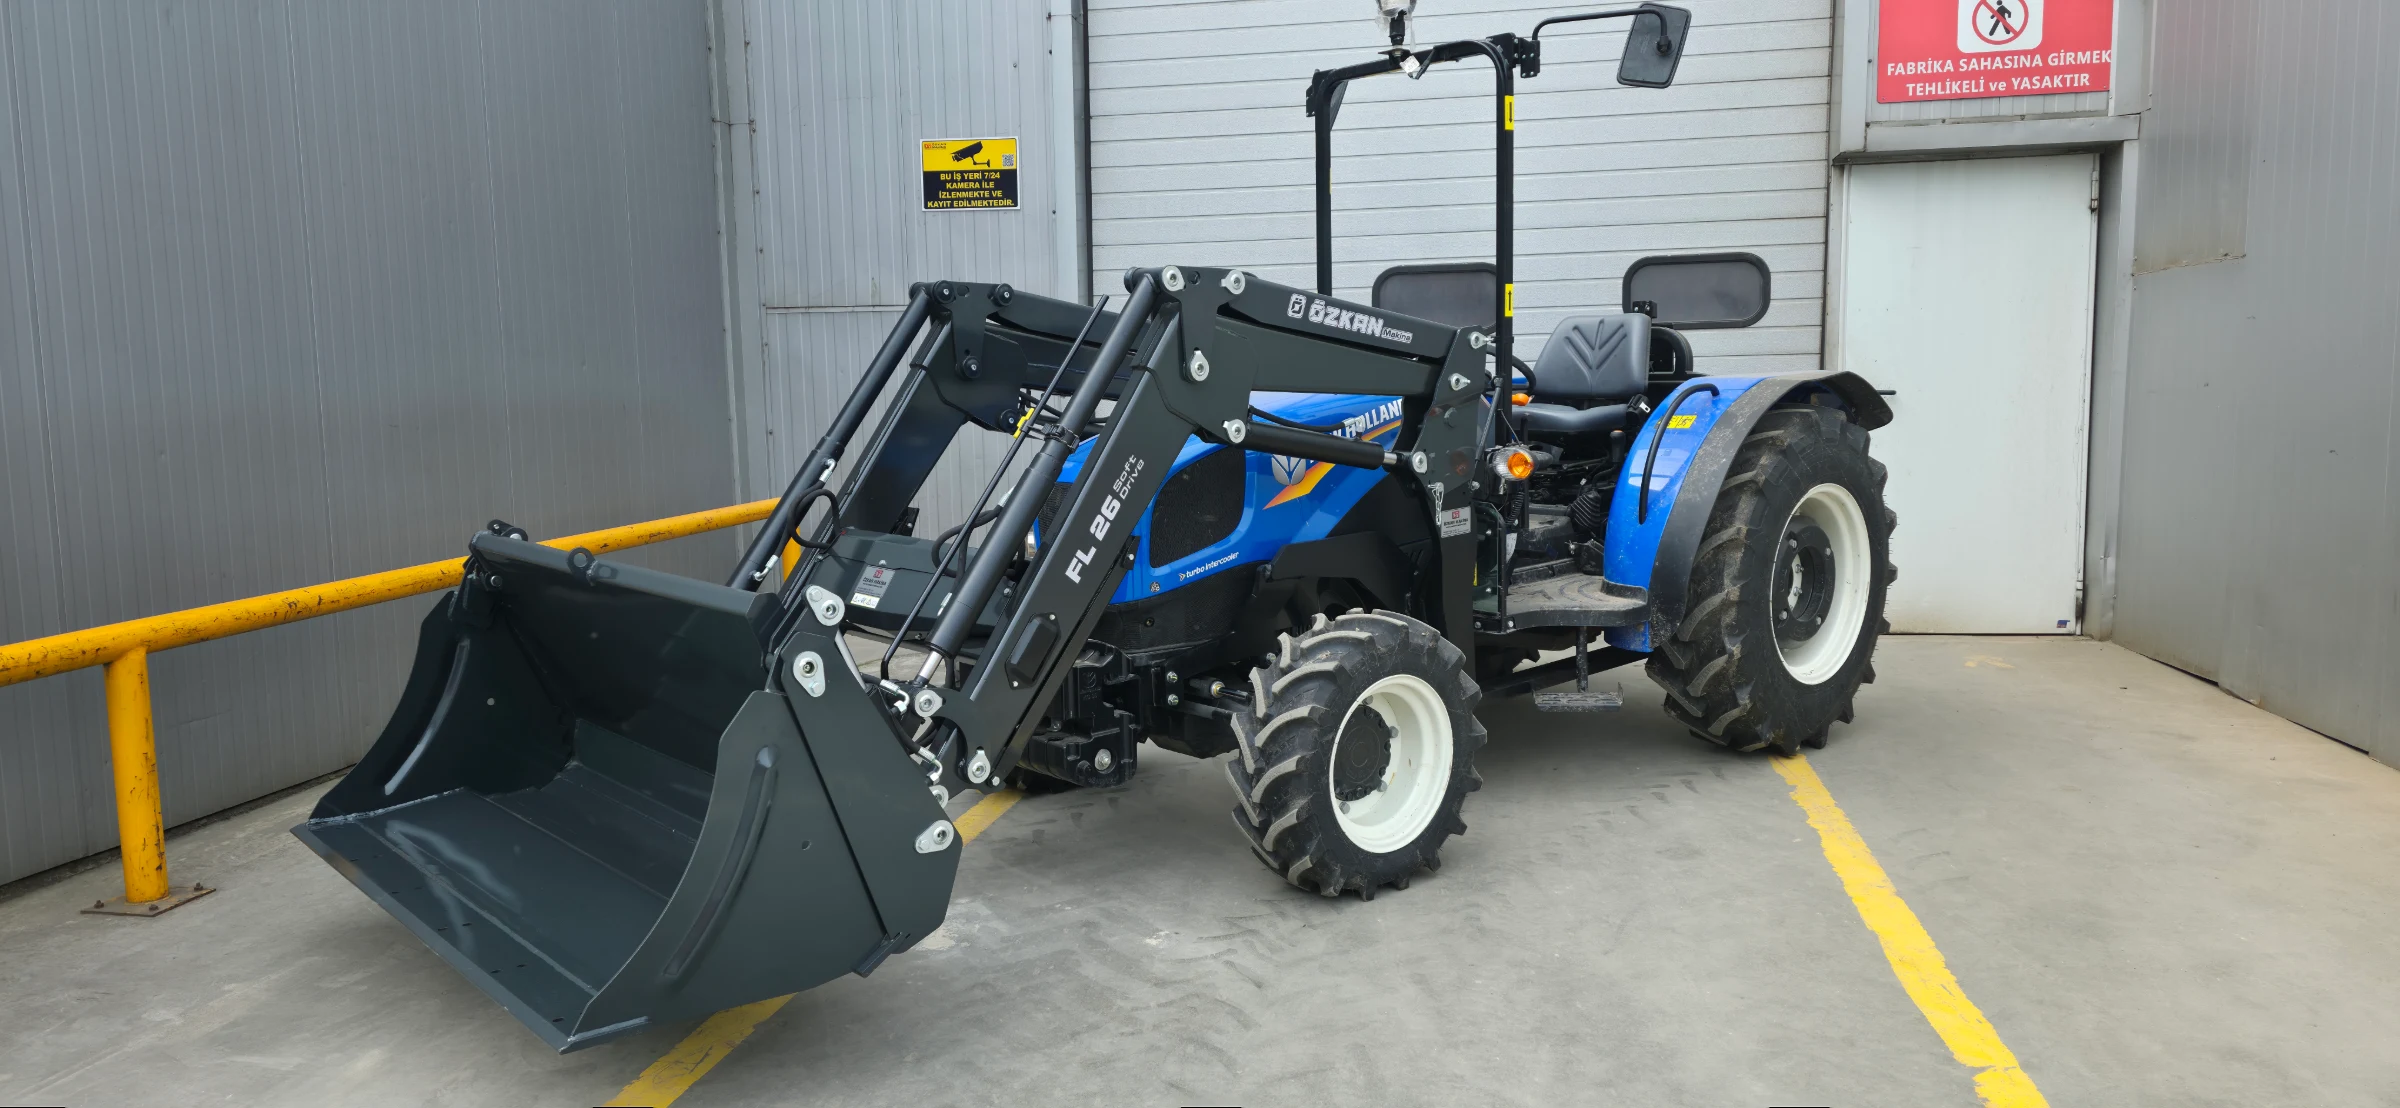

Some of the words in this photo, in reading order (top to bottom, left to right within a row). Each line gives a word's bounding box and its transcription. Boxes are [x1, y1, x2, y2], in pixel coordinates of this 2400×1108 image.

[1887, 57, 1955, 76] FABRİKA
[1959, 53, 2043, 72] SAHASINA
[2047, 49, 2112, 66] GİRMEK
[1906, 76, 1985, 97] TEHLİKELİ
[1988, 80, 2007, 92] ve
[2011, 73, 2090, 91] YASAKTIR
[953, 172, 961, 181] İŞ
[964, 172, 982, 180] YERİ
[927, 200, 951, 208] KAYIT
[953, 198, 1015, 207] EDİLMEKTEDİR.
[939, 191, 990, 199] İZLENMEKTE
[1308, 298, 1384, 337] ÖZKAN
[1382, 328, 1412, 342] Makina
[1112, 454, 1137, 493] Soft
[1119, 459, 1145, 500] Drive
[1064, 545, 1097, 584] FL
[1089, 494, 1121, 542] 26
[1186, 565, 1205, 578] turbo
